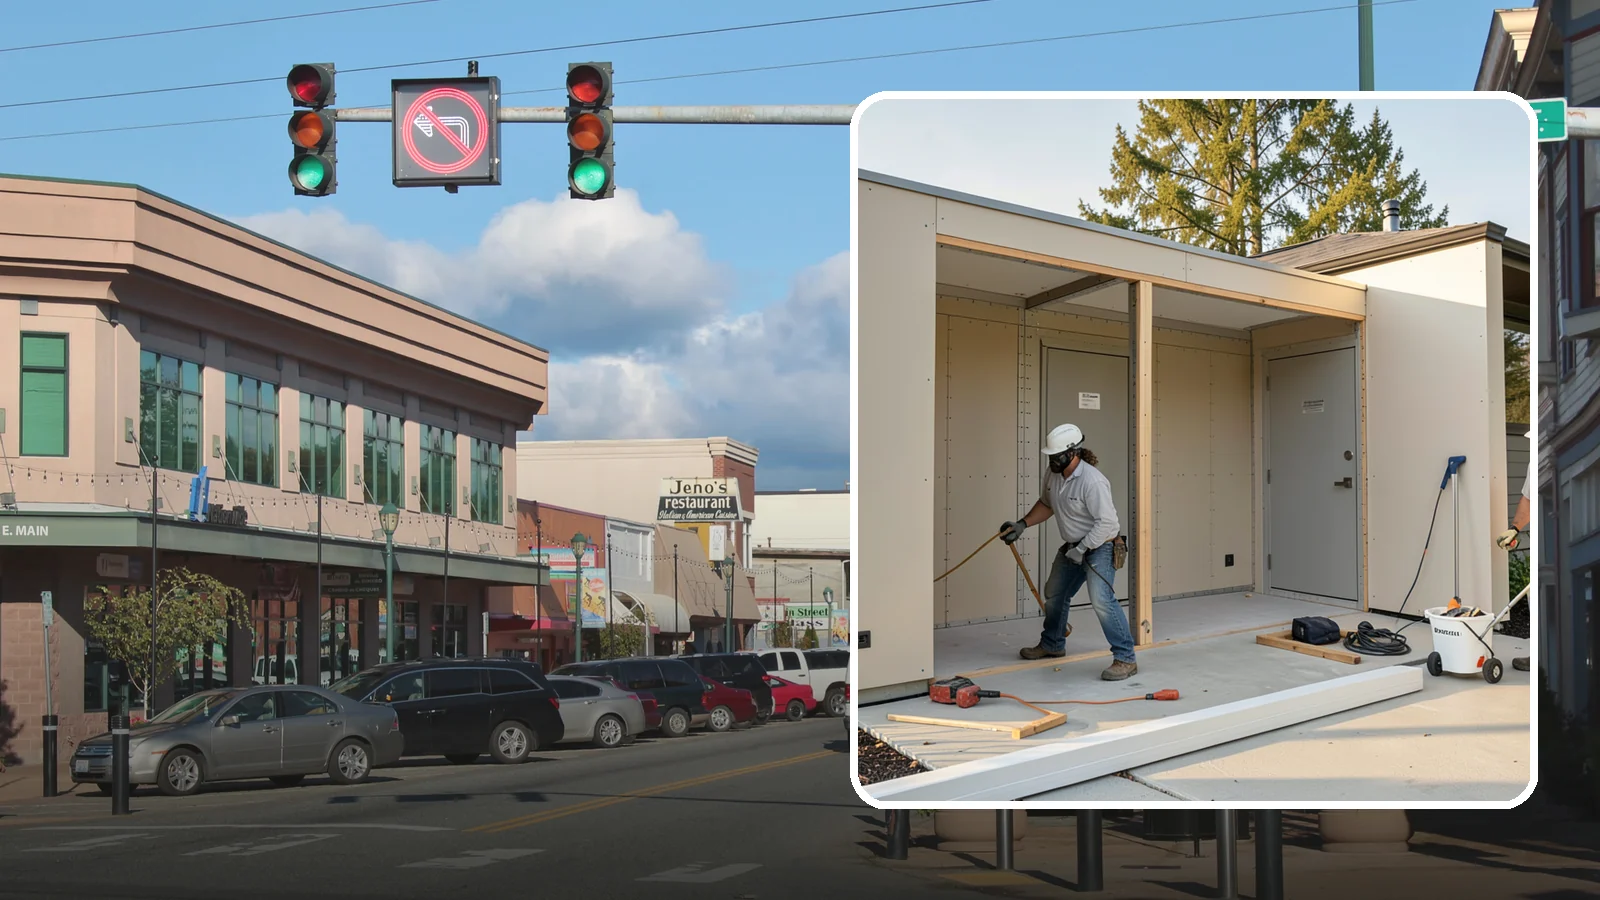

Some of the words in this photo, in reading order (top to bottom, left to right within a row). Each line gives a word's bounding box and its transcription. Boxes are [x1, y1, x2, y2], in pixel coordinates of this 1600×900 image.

[669, 480, 728, 495] Jeno's
[665, 496, 731, 509] restaurant
[658, 509, 681, 519] Italian
[686, 509, 714, 519] American
[715, 509, 738, 519] Cuisine
[2, 525, 13, 536] E.
[15, 525, 49, 536] MAIN
[797, 608, 828, 616] Street
[790, 619, 824, 627] lass
